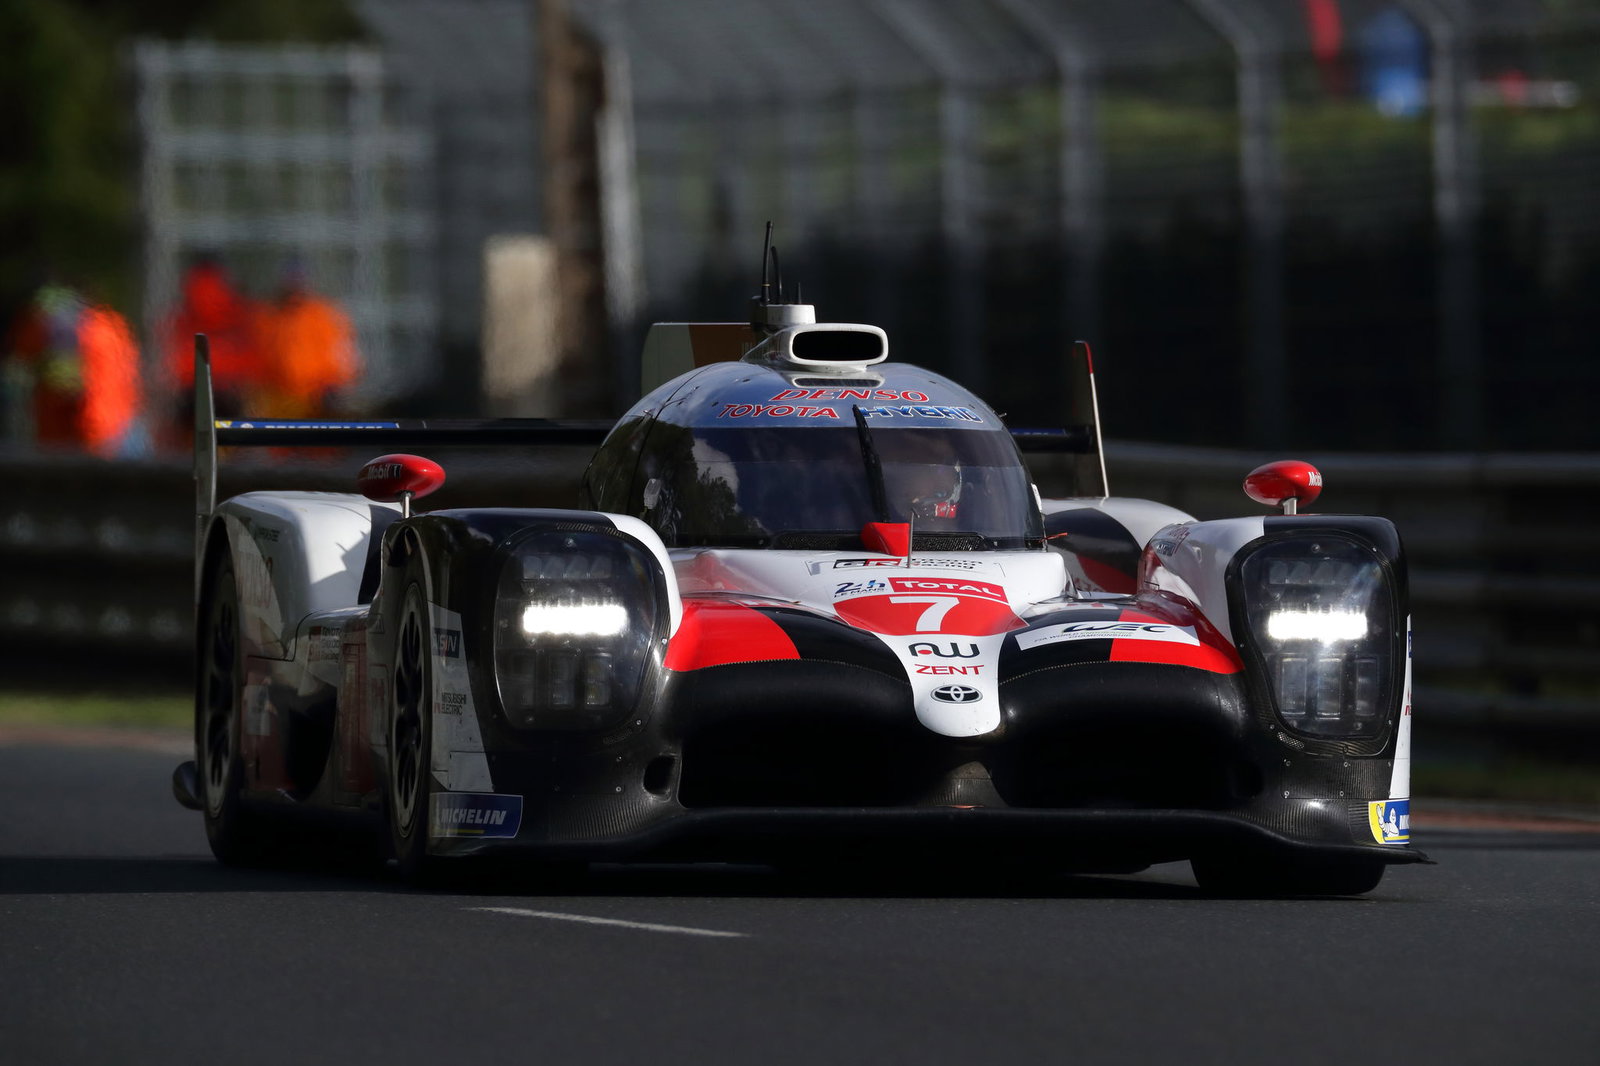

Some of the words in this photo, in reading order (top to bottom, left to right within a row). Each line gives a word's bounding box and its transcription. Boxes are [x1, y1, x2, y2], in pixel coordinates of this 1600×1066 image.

[768, 389, 930, 402] DENSO
[716, 404, 841, 419] TOYOTA
[857, 405, 984, 424] HYBRID
[368, 465, 390, 480] Mobil
[895, 580, 1002, 597] TOTAL
[888, 596, 960, 632] 7
[914, 664, 985, 675] ZENT
[440, 808, 507, 826] MICHELIN
